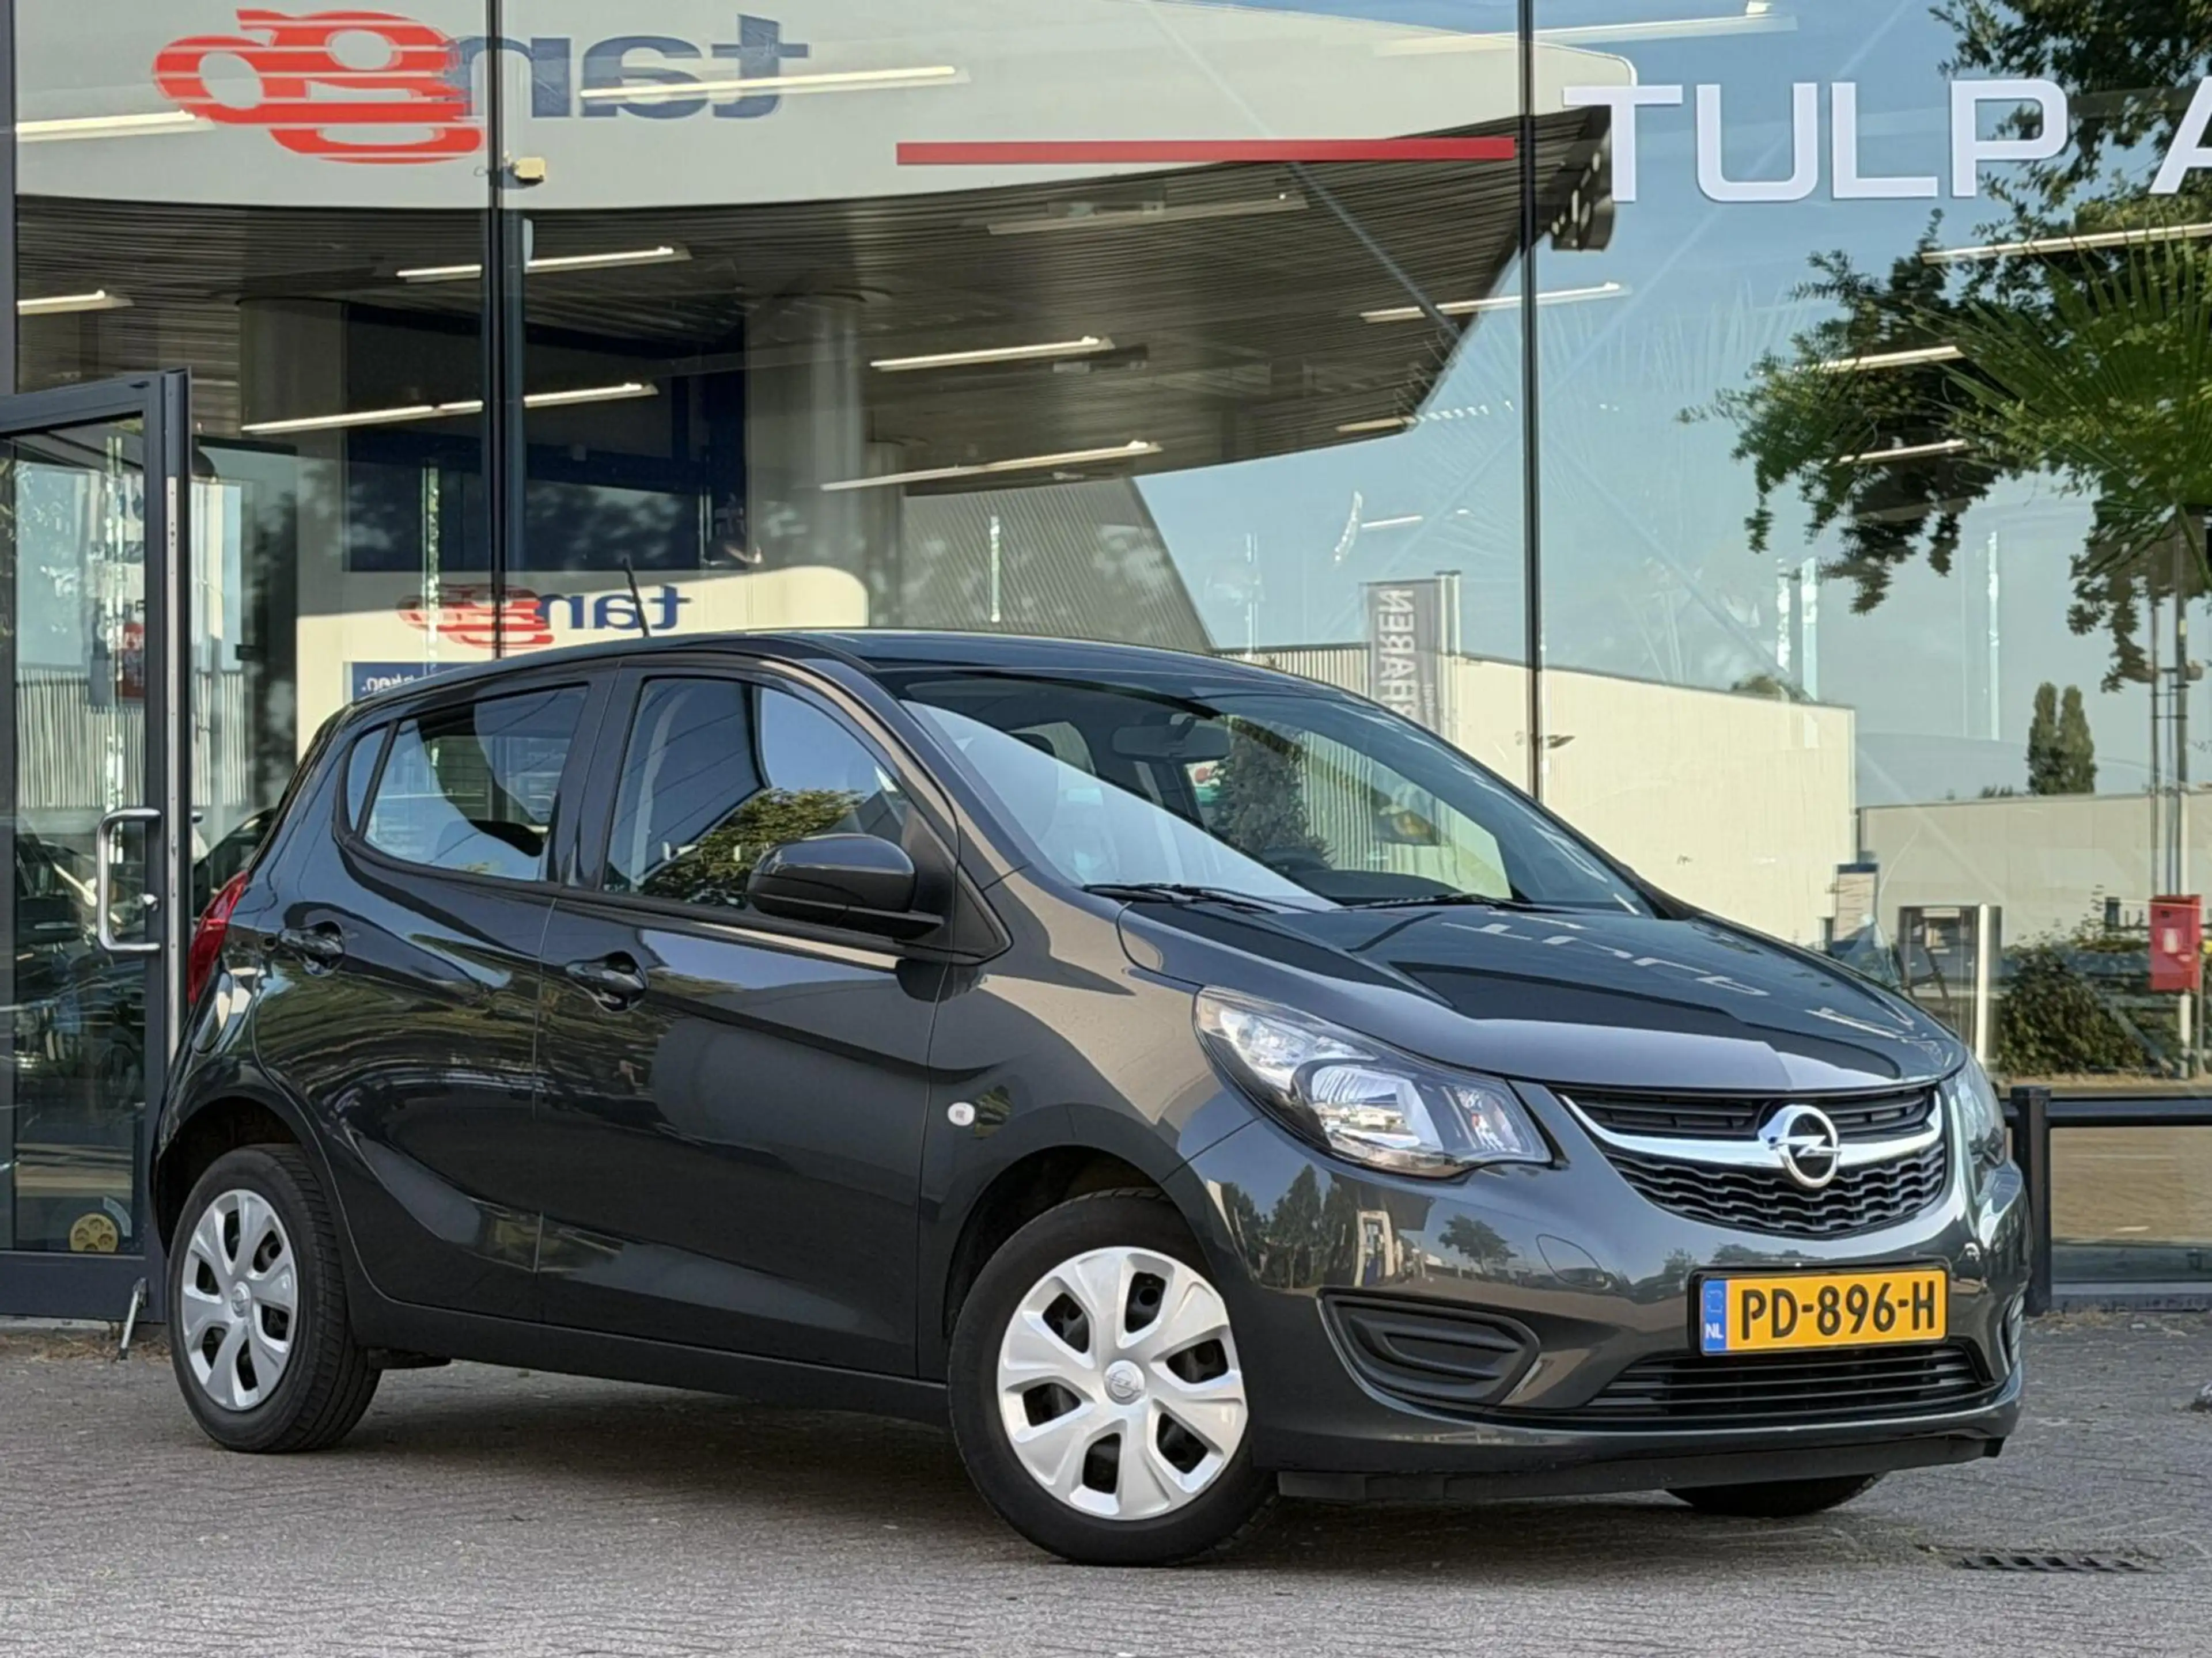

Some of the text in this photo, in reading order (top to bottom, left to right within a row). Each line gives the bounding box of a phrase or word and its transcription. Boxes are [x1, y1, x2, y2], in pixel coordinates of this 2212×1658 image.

[1562, 79, 2068, 202] TULP
[1706, 1280, 1935, 1341] NL PD-896-H
